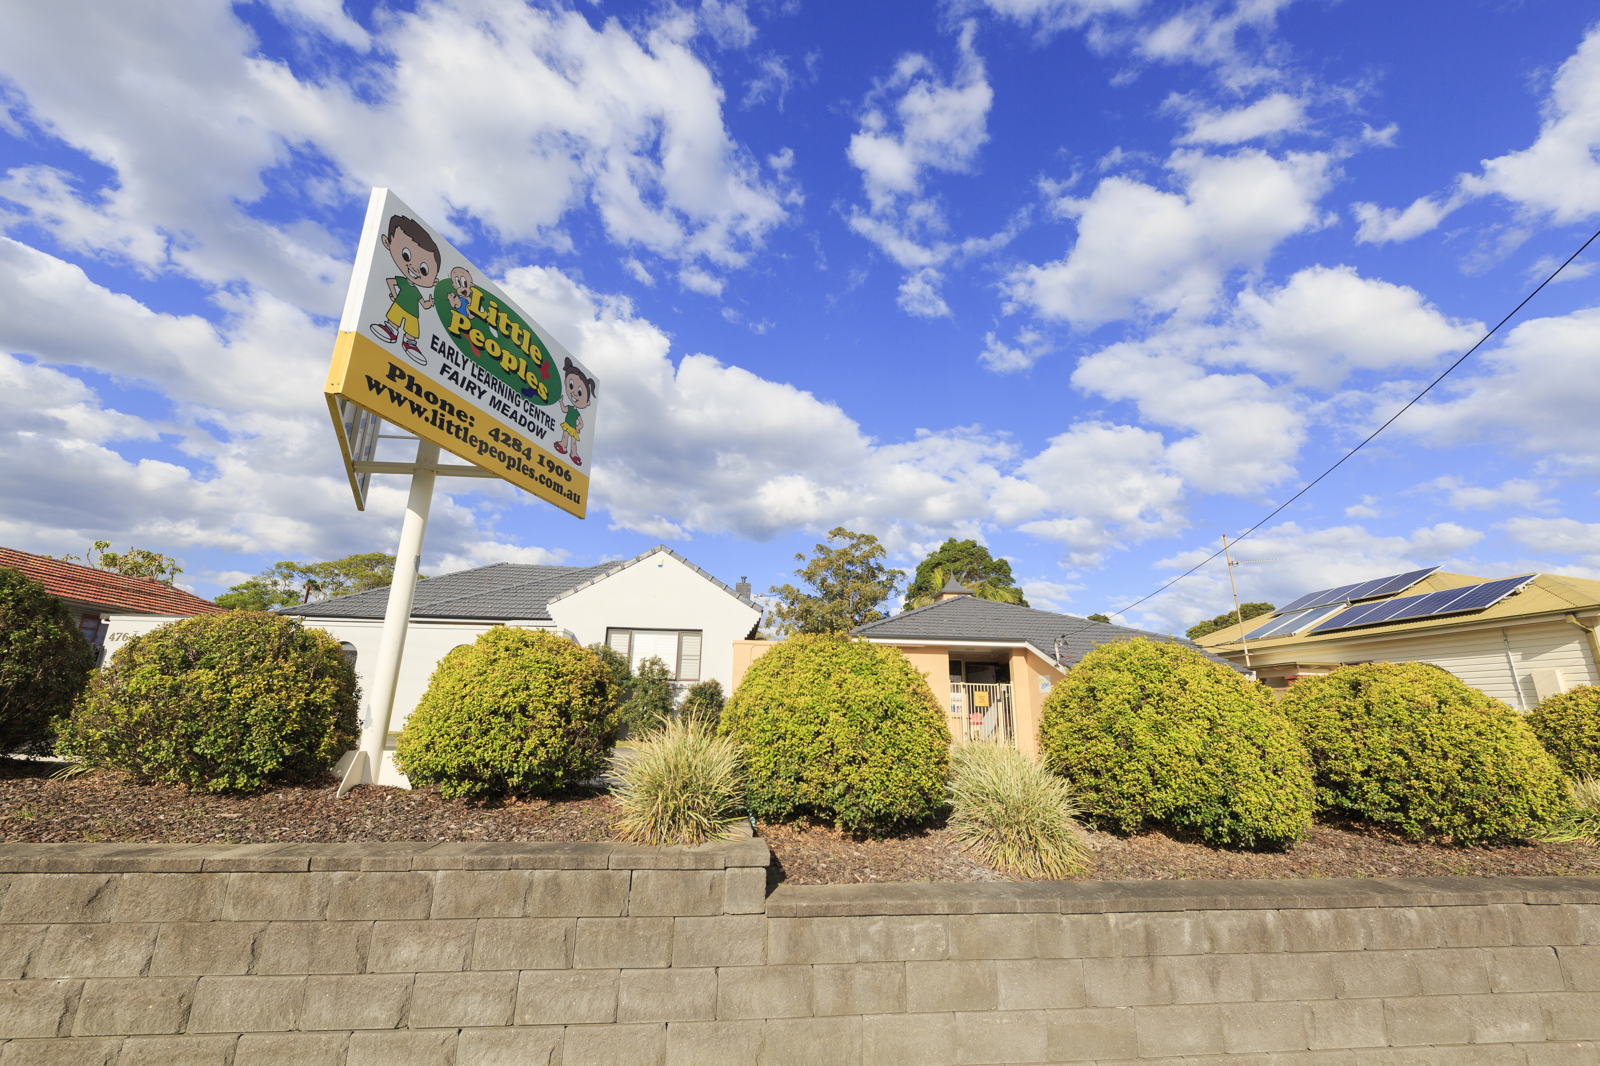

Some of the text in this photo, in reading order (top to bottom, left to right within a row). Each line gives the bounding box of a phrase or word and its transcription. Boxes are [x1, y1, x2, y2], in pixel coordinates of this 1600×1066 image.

[448, 309, 549, 403] Peoples
[467, 287, 543, 366] Little
[386, 361, 572, 482] Phone: 4284 1906
[430, 333, 556, 432] EARLY LEARNING CENTRE
[440, 363, 548, 440] FAIRY MEADOW
[365, 374, 581, 505] www.littlepeoples.com.au
[108, 632, 129, 642] 476
